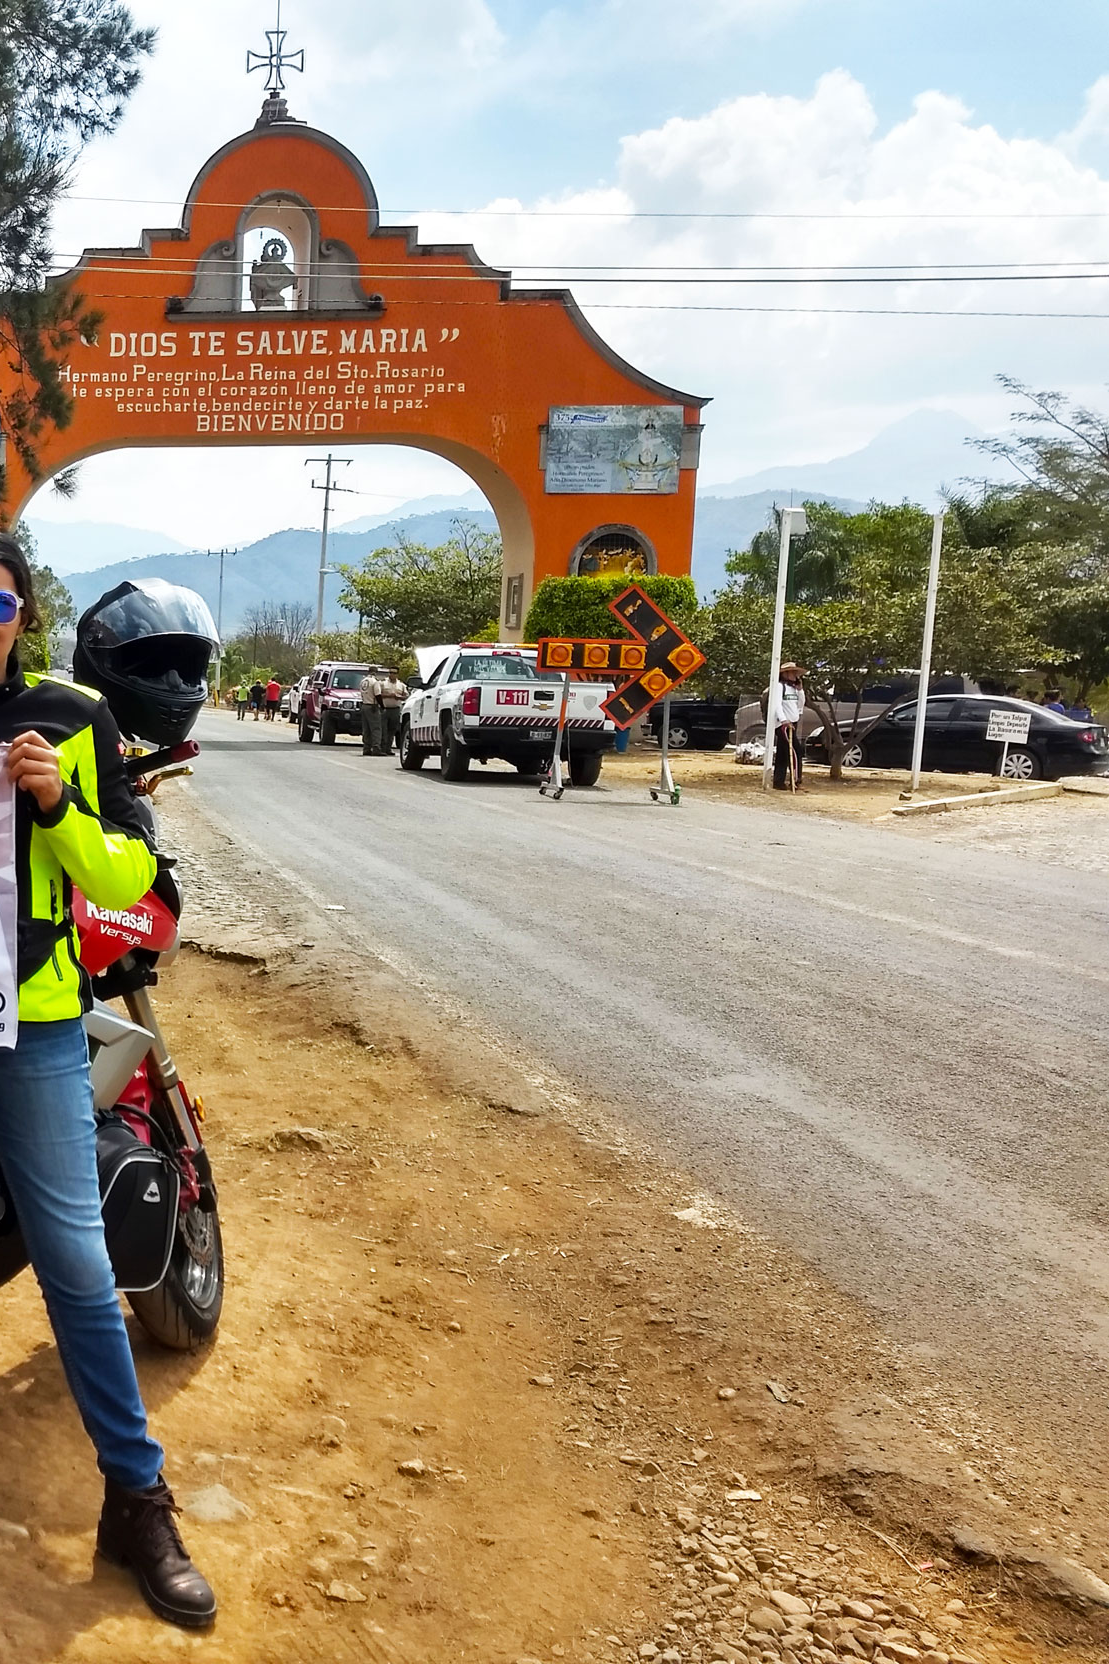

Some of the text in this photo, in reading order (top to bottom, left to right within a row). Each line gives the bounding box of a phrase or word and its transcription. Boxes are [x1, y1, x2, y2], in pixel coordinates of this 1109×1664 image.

[109, 332, 177, 357] DIOS
[189, 331, 225, 357] TE
[339, 328, 428, 354] MARIA
[58, 365, 128, 383] Hermano
[249, 363, 296, 381] Reina
[303, 365, 330, 380] del
[72, 380, 465, 402] te espera con el corazón lleno de amor para
[308, 400, 318, 414] y
[323, 397, 369, 411] darte
[374, 396, 388, 410] la
[196, 412, 345, 432] BIENVENIDO
[86, 899, 153, 936] Kawasaki
